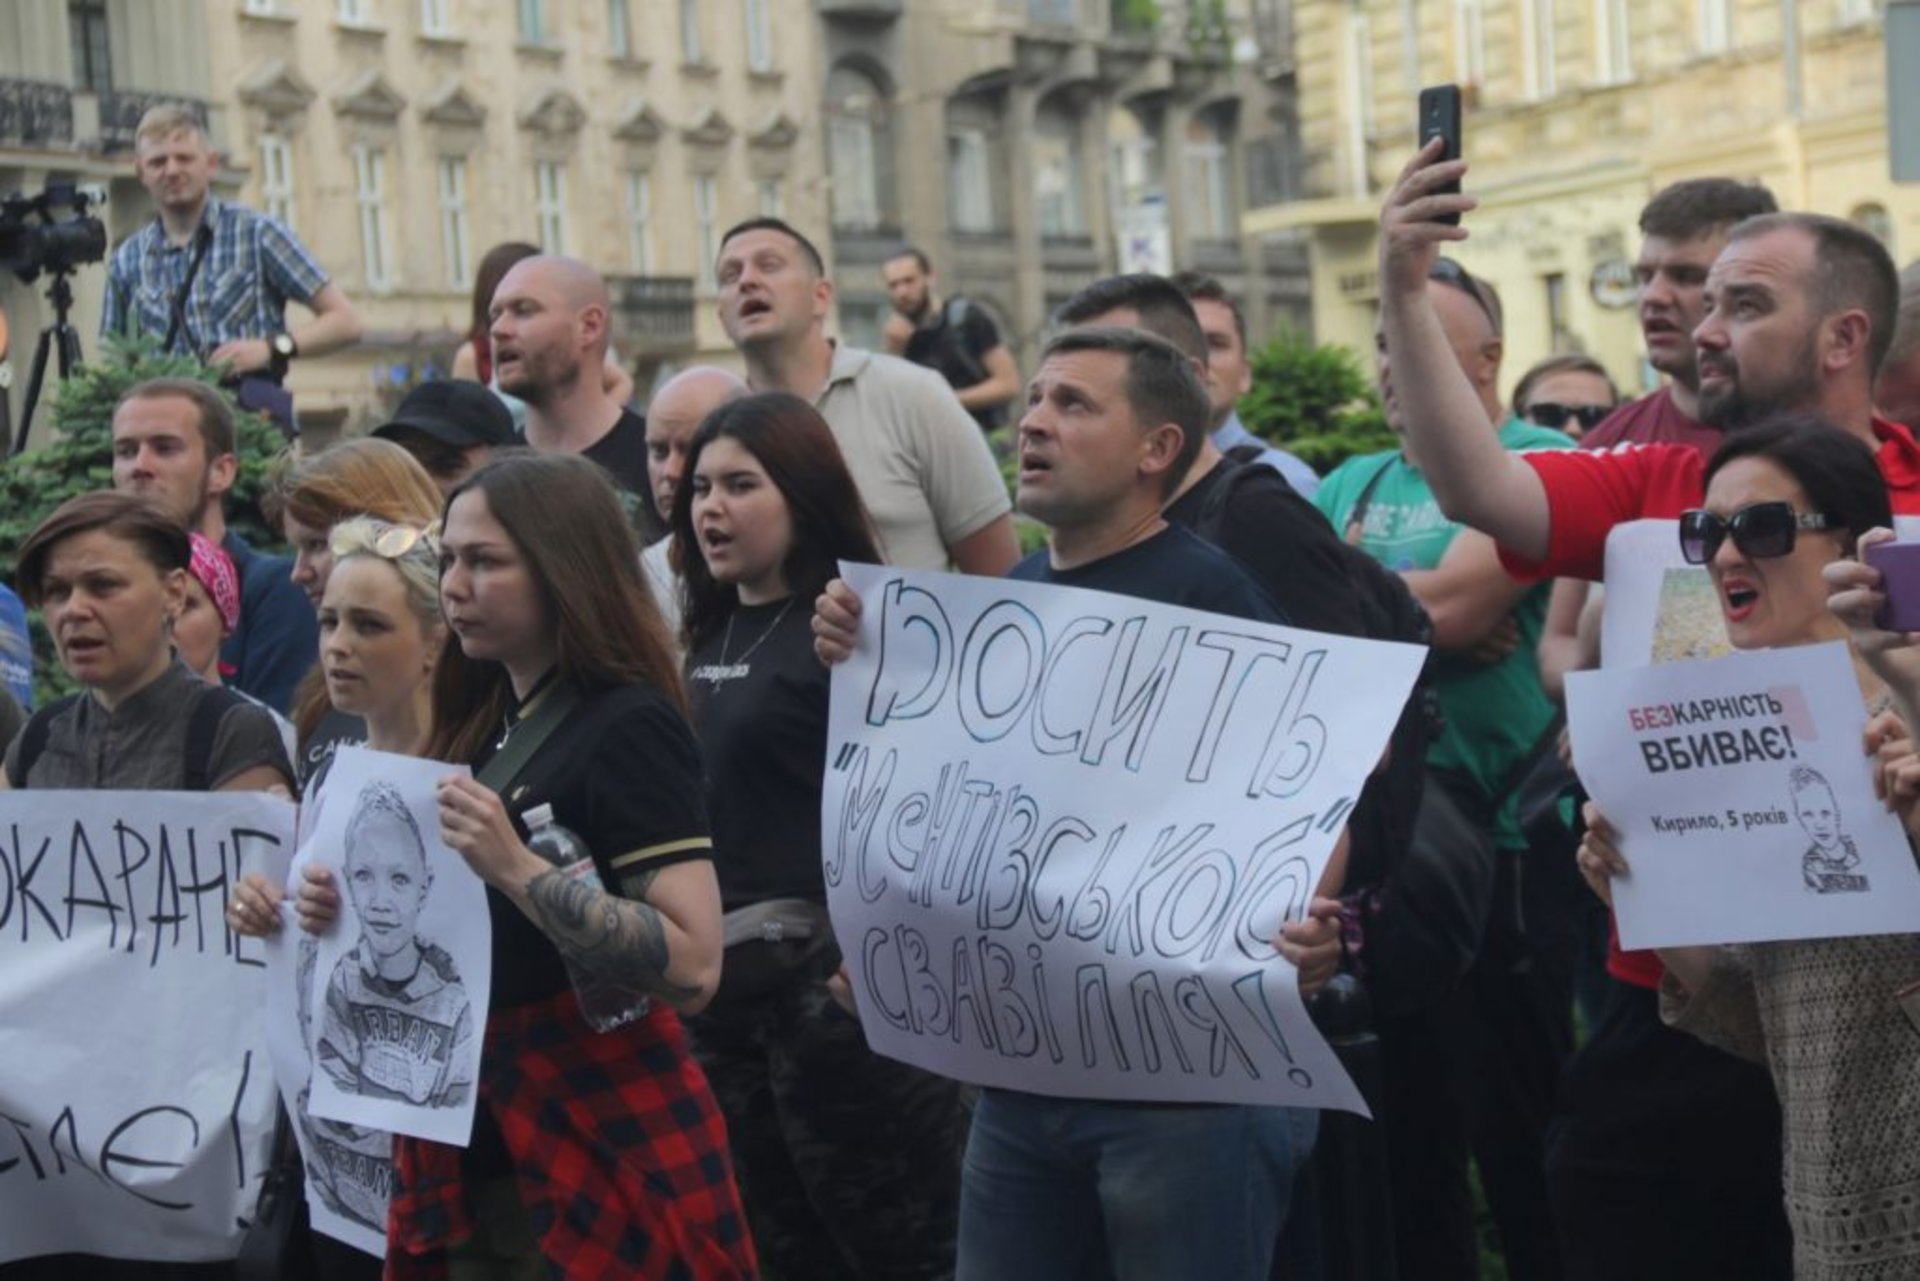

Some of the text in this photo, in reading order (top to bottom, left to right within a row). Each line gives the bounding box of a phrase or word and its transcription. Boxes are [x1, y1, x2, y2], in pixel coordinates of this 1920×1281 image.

[1629, 692, 1783, 731] БЕЗКАРНІСТЬ
[1639, 725, 1798, 774] ВБИВАЄ!
[1651, 805, 1788, 836] Кирило, 5 років
[0, 819, 280, 967] КАРАНЕ
